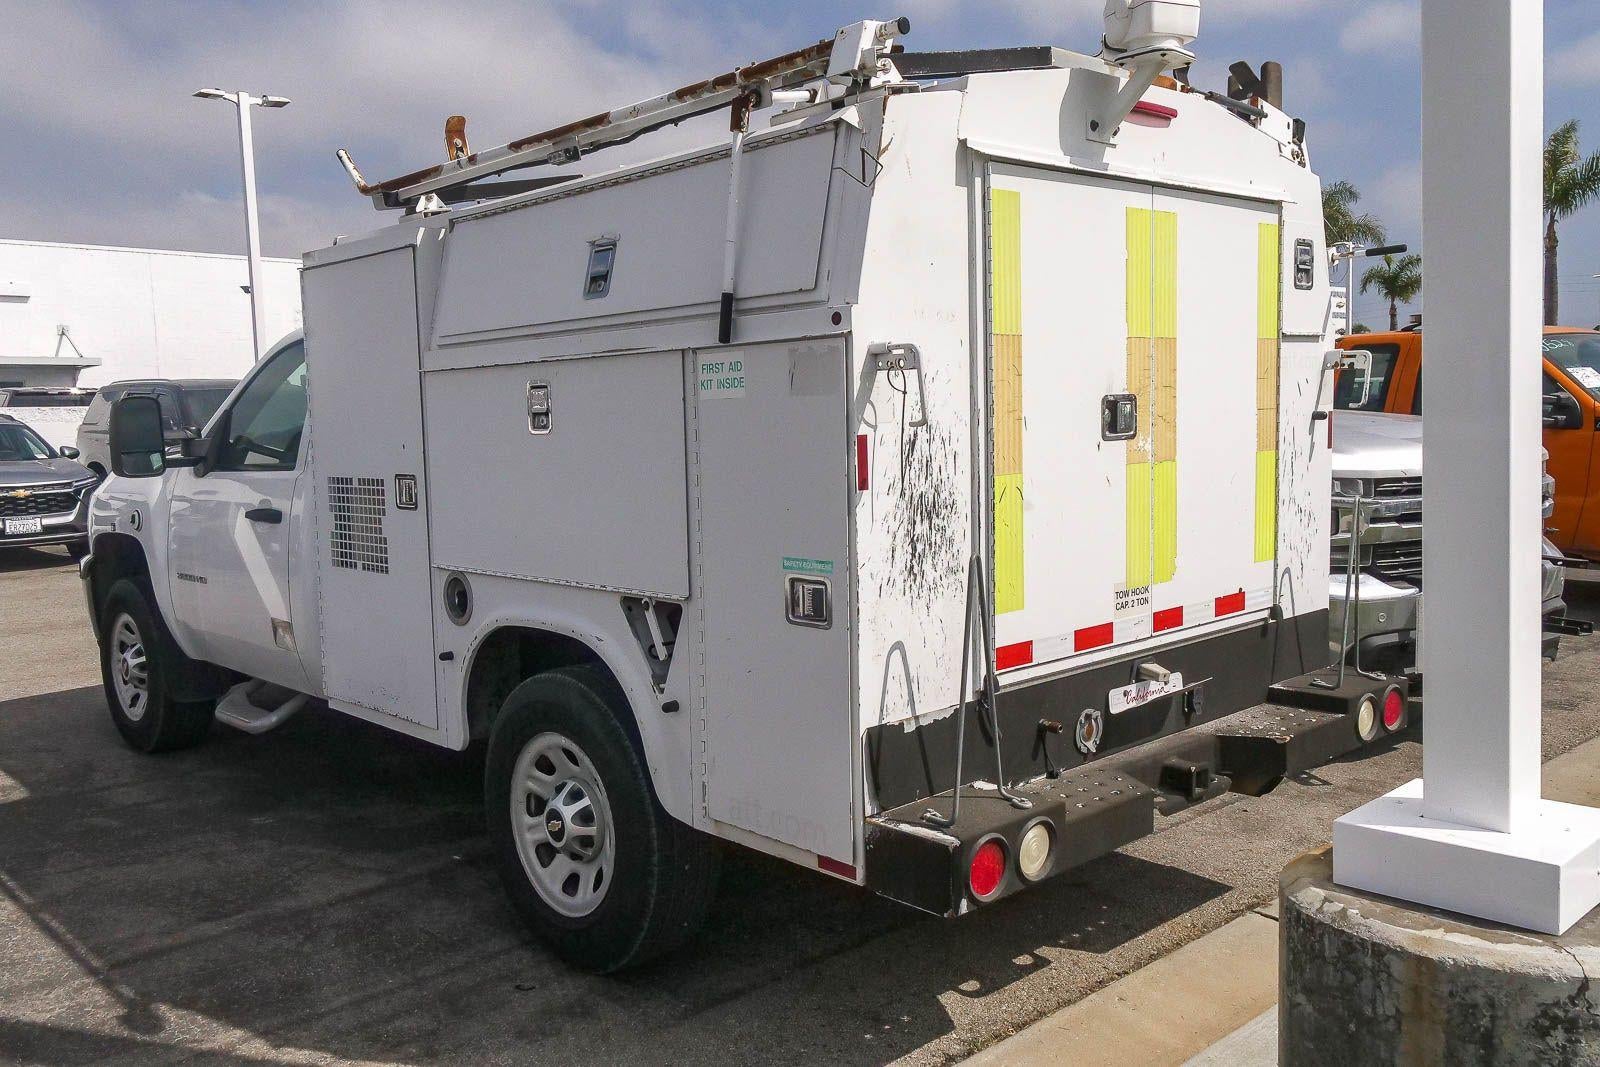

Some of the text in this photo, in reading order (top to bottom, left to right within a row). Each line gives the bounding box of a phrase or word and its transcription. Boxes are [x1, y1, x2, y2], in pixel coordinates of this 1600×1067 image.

[701, 360, 743, 374] FIRST AID
[700, 376, 745, 390] KIT INSIDE
[784, 559, 802, 569] SAFETY
[1115, 585, 1150, 600] TOW HOOK
[1115, 597, 1149, 611] CAP. 2 TON
[1123, 685, 1170, 705] California
